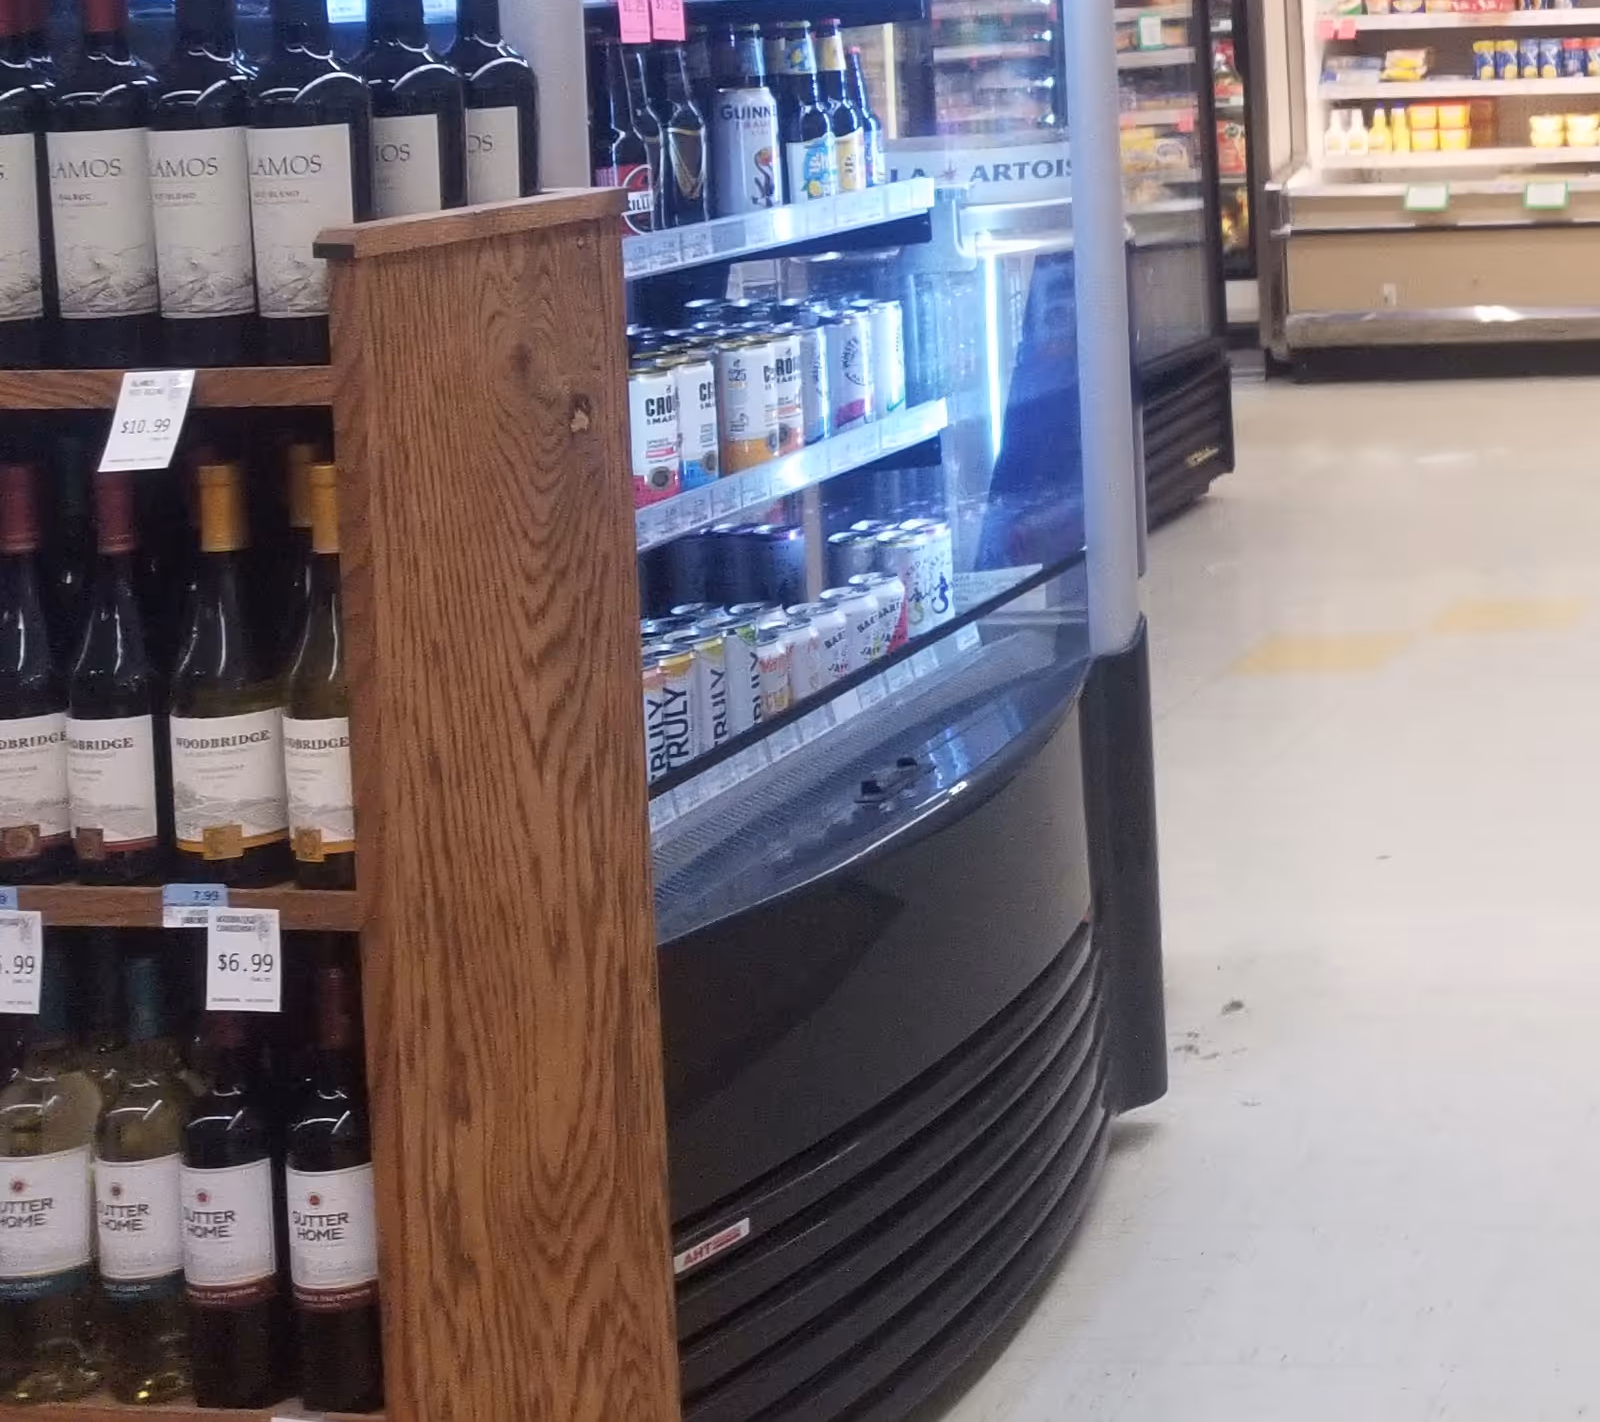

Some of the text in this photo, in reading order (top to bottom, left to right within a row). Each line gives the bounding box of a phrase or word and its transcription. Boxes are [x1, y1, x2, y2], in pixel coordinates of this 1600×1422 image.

[120, 418, 171, 434] $10.99
[0, 954, 35, 975] .99
[217, 952, 274, 973] $6.99
[296, 1227, 346, 1242] HOME
